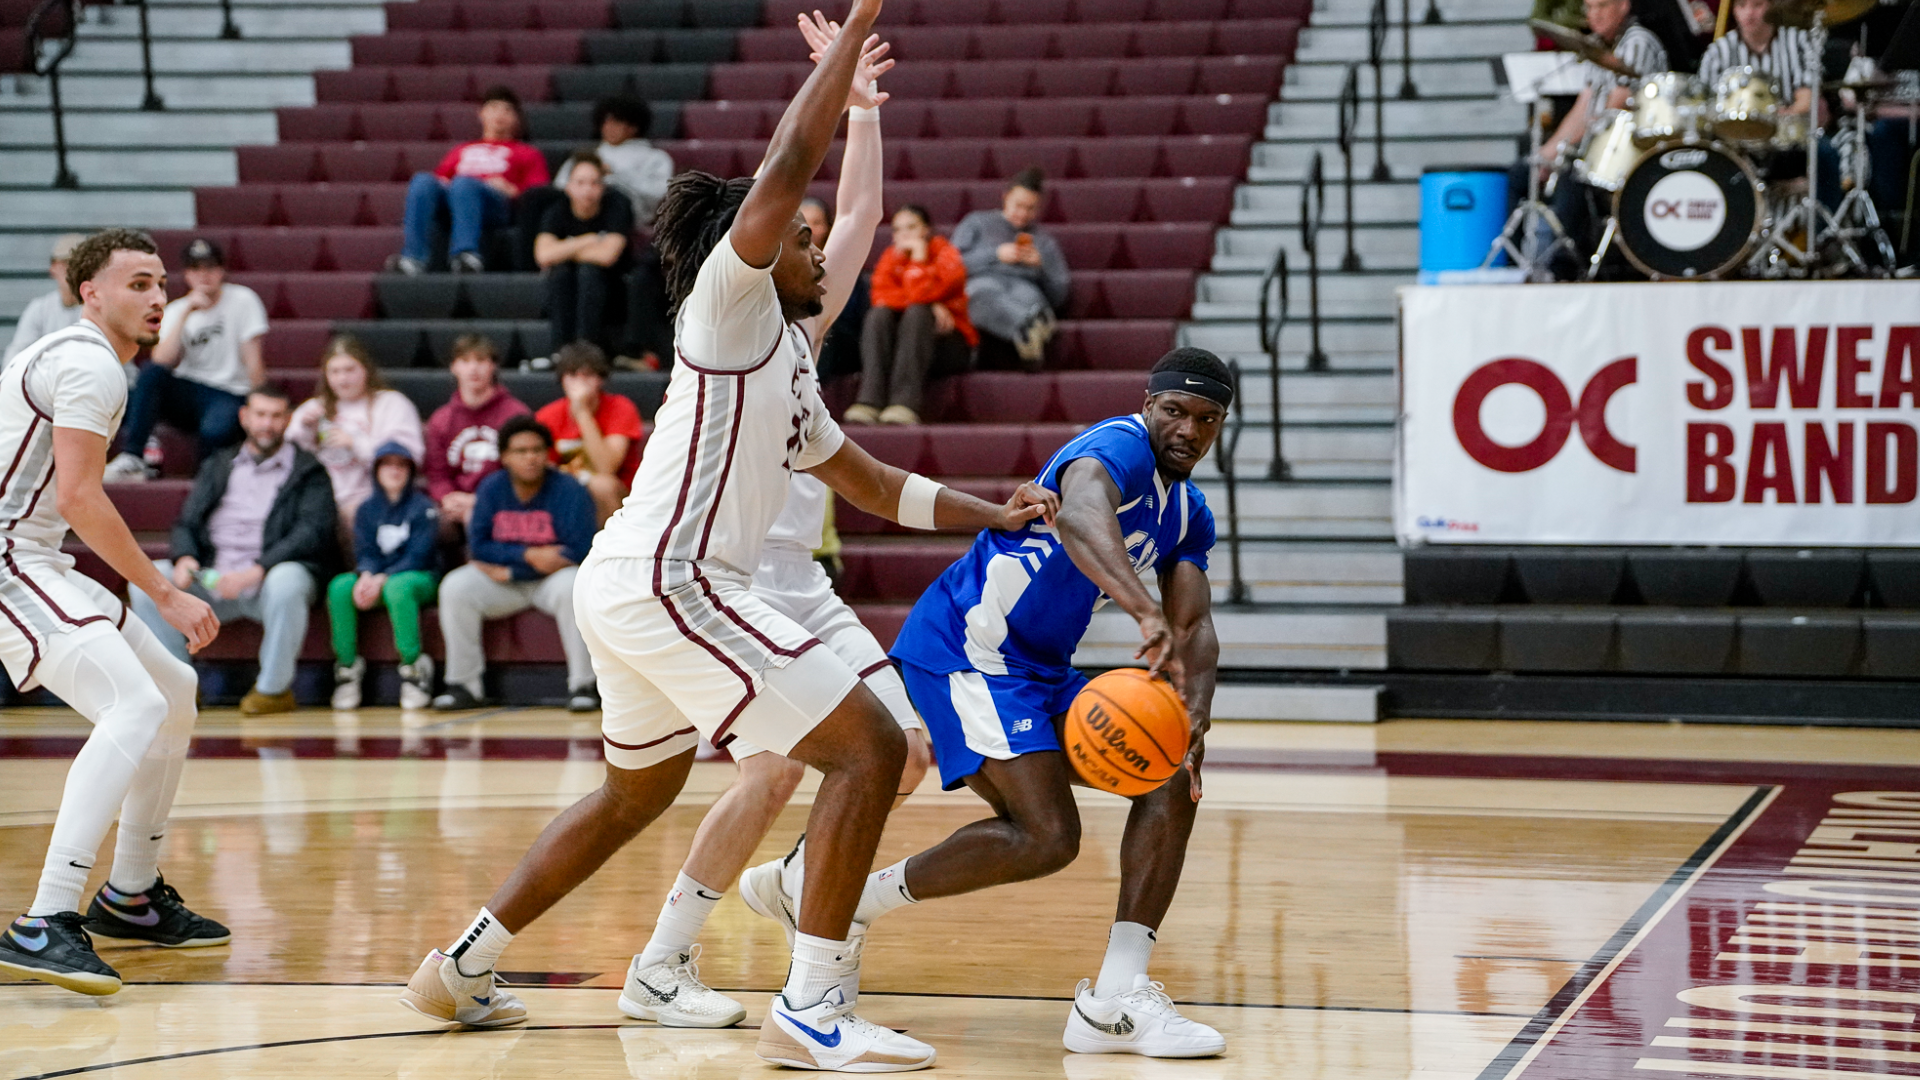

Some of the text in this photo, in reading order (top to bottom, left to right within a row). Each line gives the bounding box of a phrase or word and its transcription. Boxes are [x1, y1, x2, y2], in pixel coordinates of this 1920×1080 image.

[1453, 357, 1637, 474] OC
[1686, 422, 1918, 504] BAND
[1086, 702, 1151, 773] Wilson
